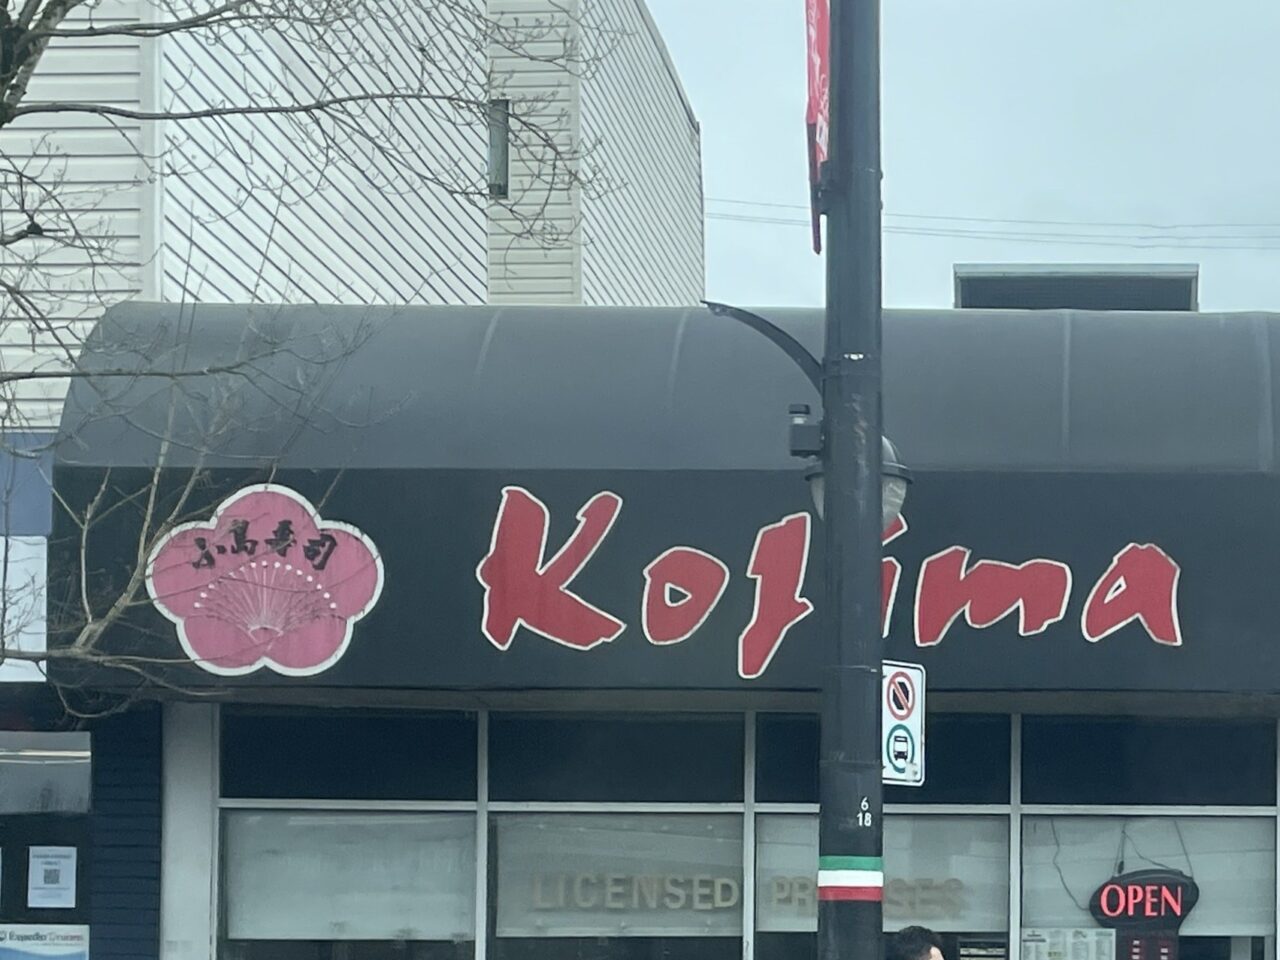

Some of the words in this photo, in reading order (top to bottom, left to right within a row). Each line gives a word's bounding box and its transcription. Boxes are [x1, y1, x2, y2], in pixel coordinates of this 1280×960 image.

[860, 796, 869, 811] 6
[856, 811, 872, 827] 18
[530, 872, 740, 911] LICENSED
[774, 877, 966, 918] PRSES
[1100, 884, 1182, 917] OPEN
